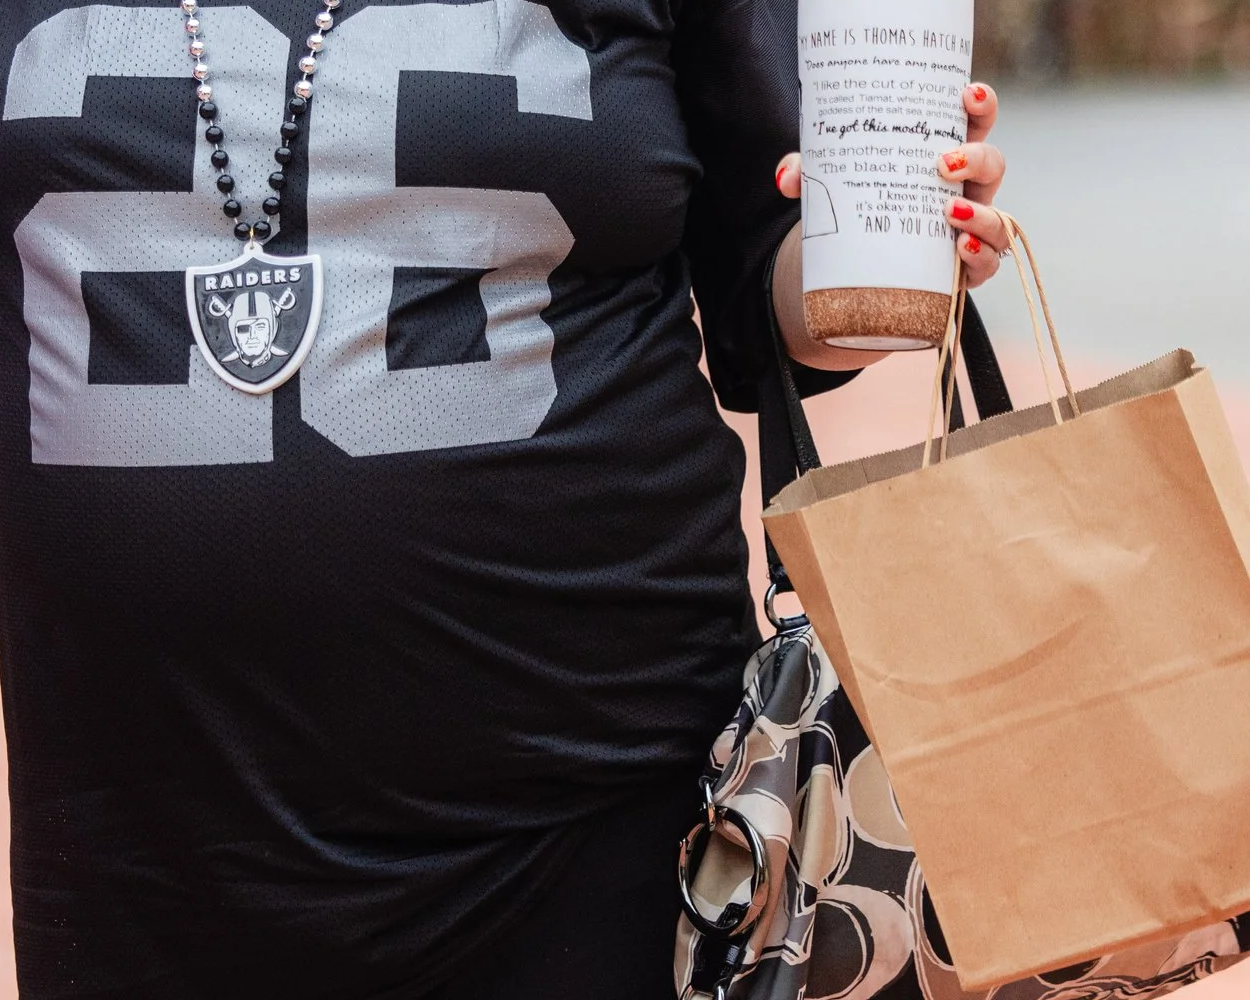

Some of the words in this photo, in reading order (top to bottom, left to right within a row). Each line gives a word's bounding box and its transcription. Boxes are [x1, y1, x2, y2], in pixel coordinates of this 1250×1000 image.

[810, 29, 836, 48] NAME
[844, 28, 856, 46] IS
[864, 27, 916, 46] THOMAS
[923, 29, 956, 52] HATCH
[827, 59, 869, 70] anyone
[872, 56, 901, 66] have
[905, 60, 927, 72] any
[821, 81, 841, 90] like
[844, 79, 867, 89] the
[871, 80, 895, 89] cut
[900, 80, 914, 89] of
[918, 83, 946, 94] your
[830, 95, 855, 103] called
[897, 96, 925, 105] which
[818, 106, 853, 117] goddess
[855, 105, 865, 113] of
[926, 110, 941, 119] and
[839, 119, 859, 139] got
[863, 118, 888, 132] this
[892, 121, 930, 141] mostly
[839, 146, 893, 156] another
[899, 146, 935, 159] kettle
[854, 161, 897, 173] black
[906, 164, 943, 177] plagu
[878, 190, 883, 200] I
[887, 191, 917, 202] know
[922, 193, 936, 205] it's
[856, 200, 873, 211] it's
[876, 202, 904, 215] okay
[908, 204, 919, 213] to
[922, 204, 940, 216] like
[899, 216, 921, 236] YOU
[204, 267, 302, 292] RAIDERS
